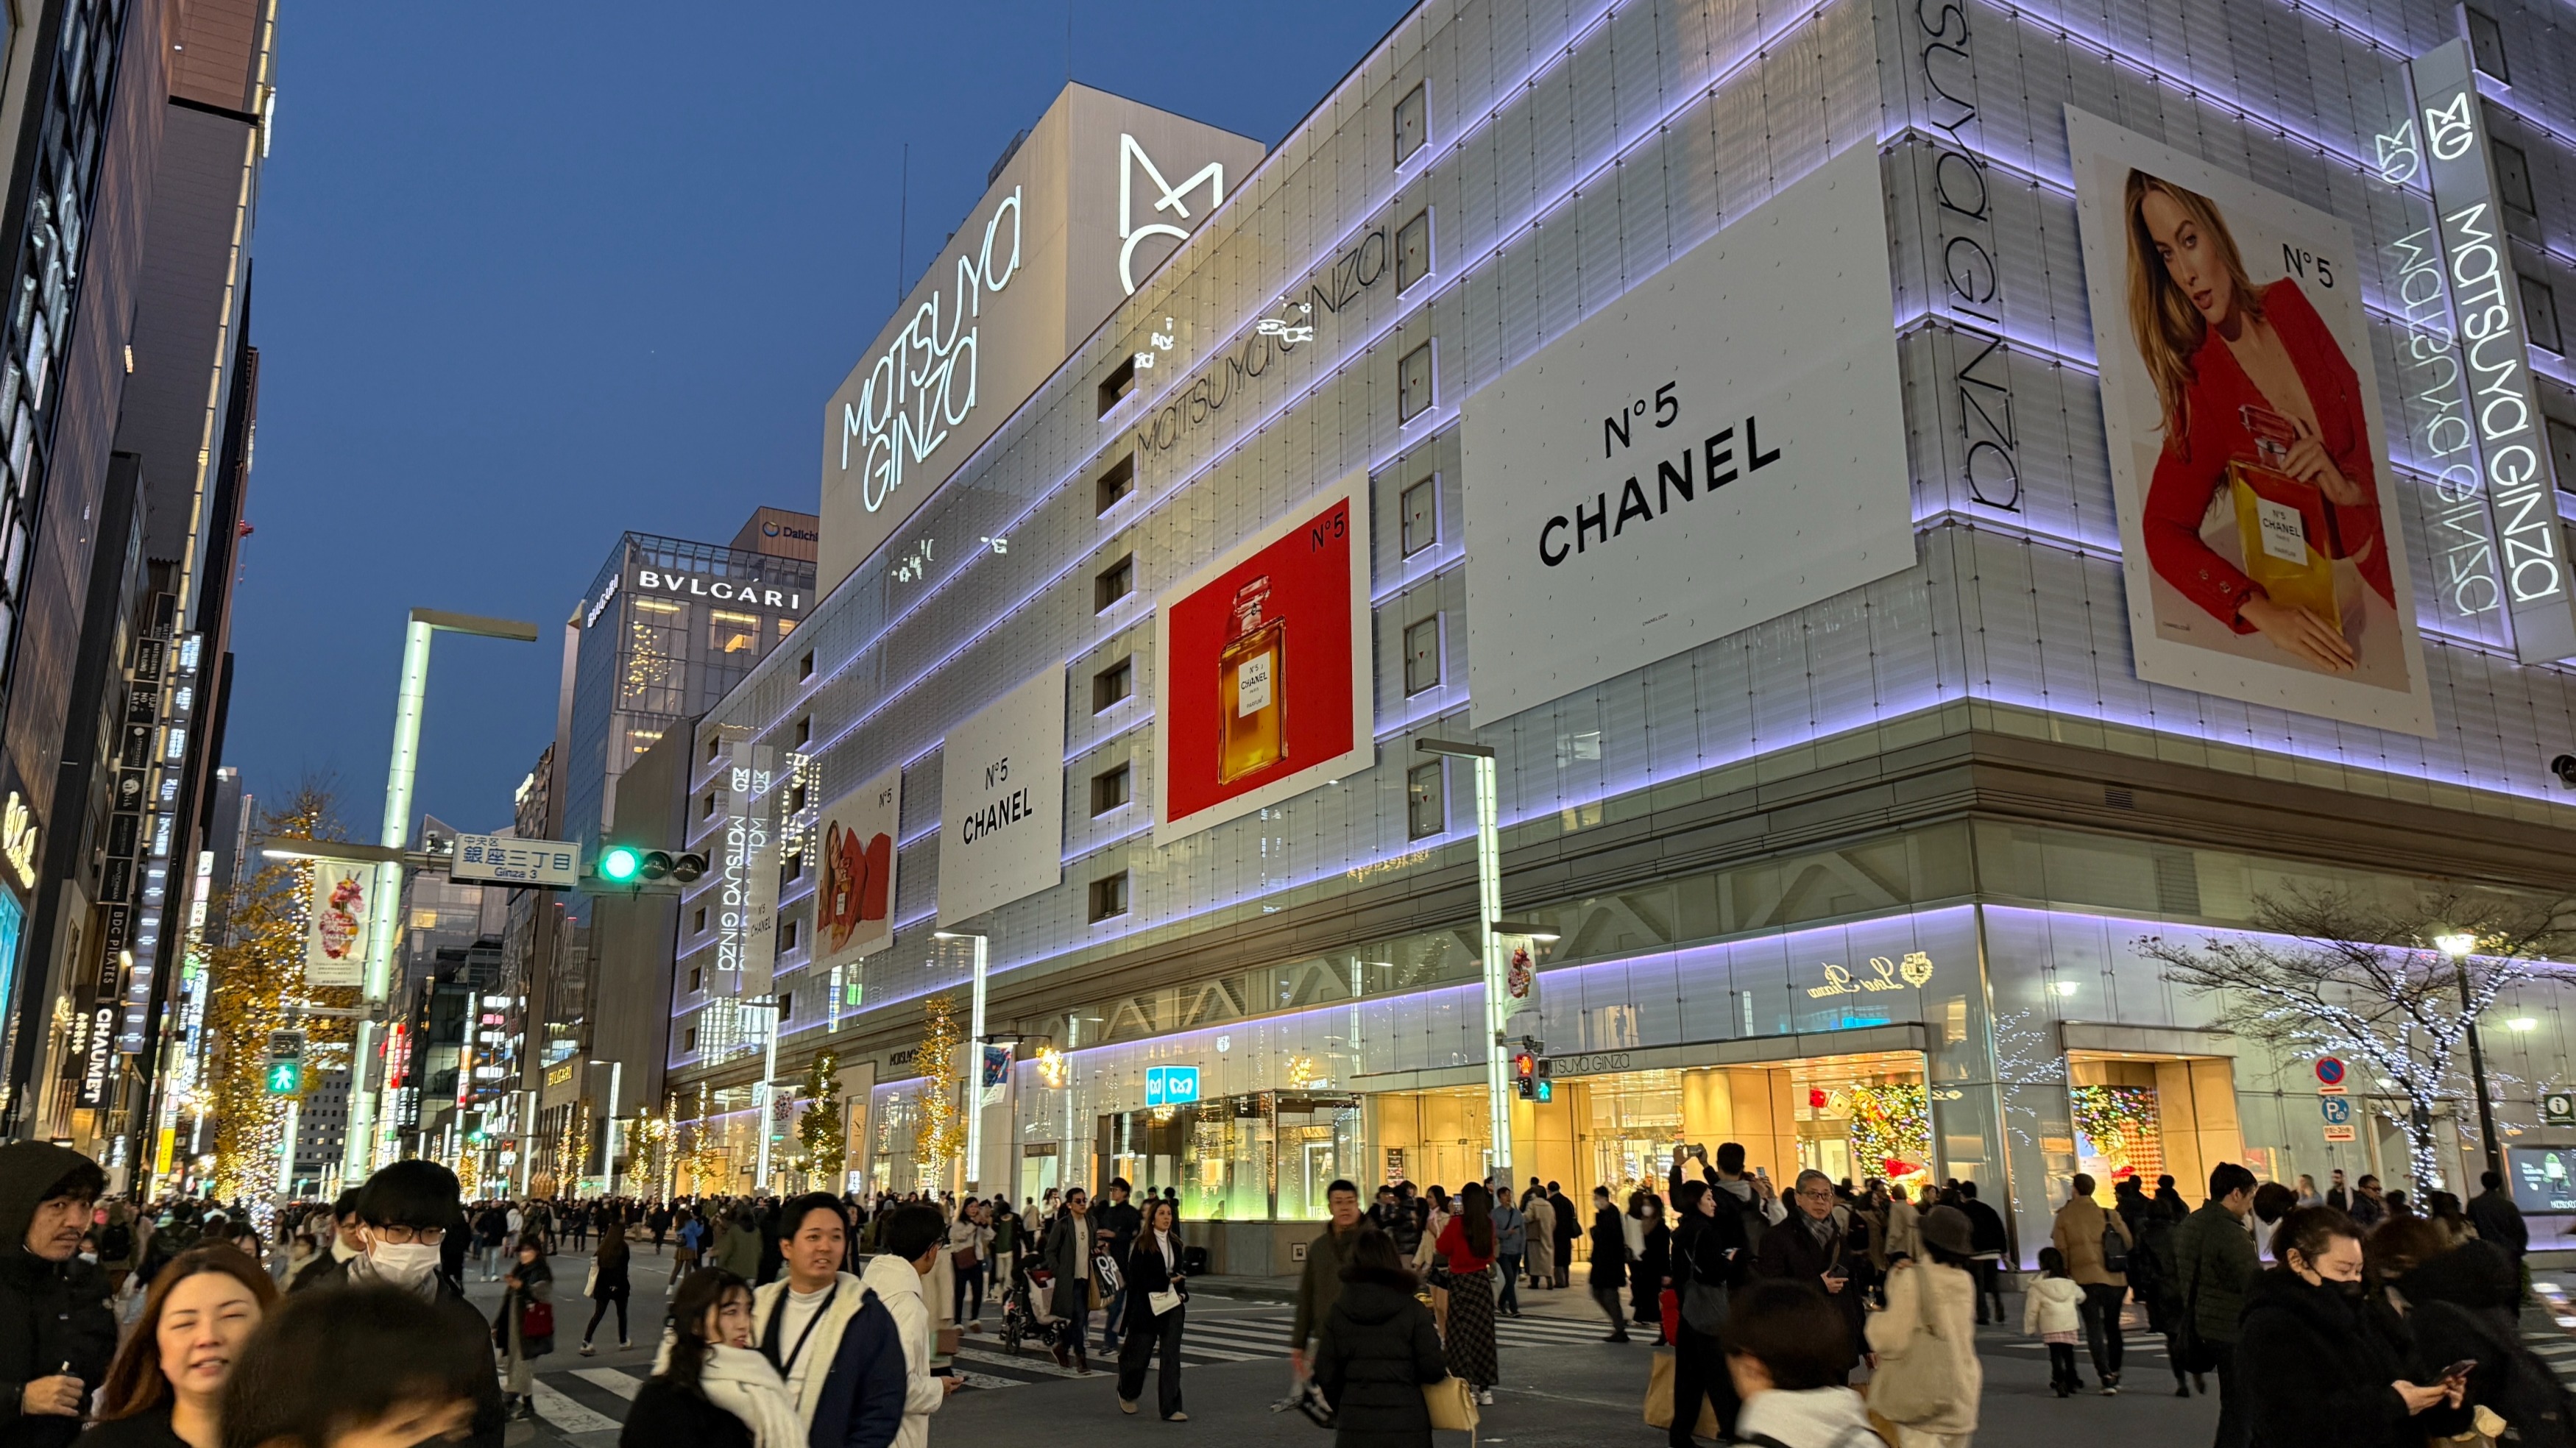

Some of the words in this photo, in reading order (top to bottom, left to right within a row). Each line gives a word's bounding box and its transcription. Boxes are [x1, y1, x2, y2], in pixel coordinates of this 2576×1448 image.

[1539, 415, 1780, 567] CHANEL
[2262, 518, 2300, 537] CHANEL
[640, 571, 799, 609] BVLGARI
[1241, 671, 1267, 689] CHANEL
[963, 787, 1033, 845] CHANEL
[464, 836, 499, 847] 中央区
[463, 846, 570, 870] 銀座三丁目
[495, 867, 526, 879] Ginza
[530, 870, 537, 879] 3
[110, 911, 124, 934] BDC
[750, 916, 771, 937] CHANEL
[103, 940, 120, 984] PILATES
[85, 1008, 113, 1104] CHAUMET
